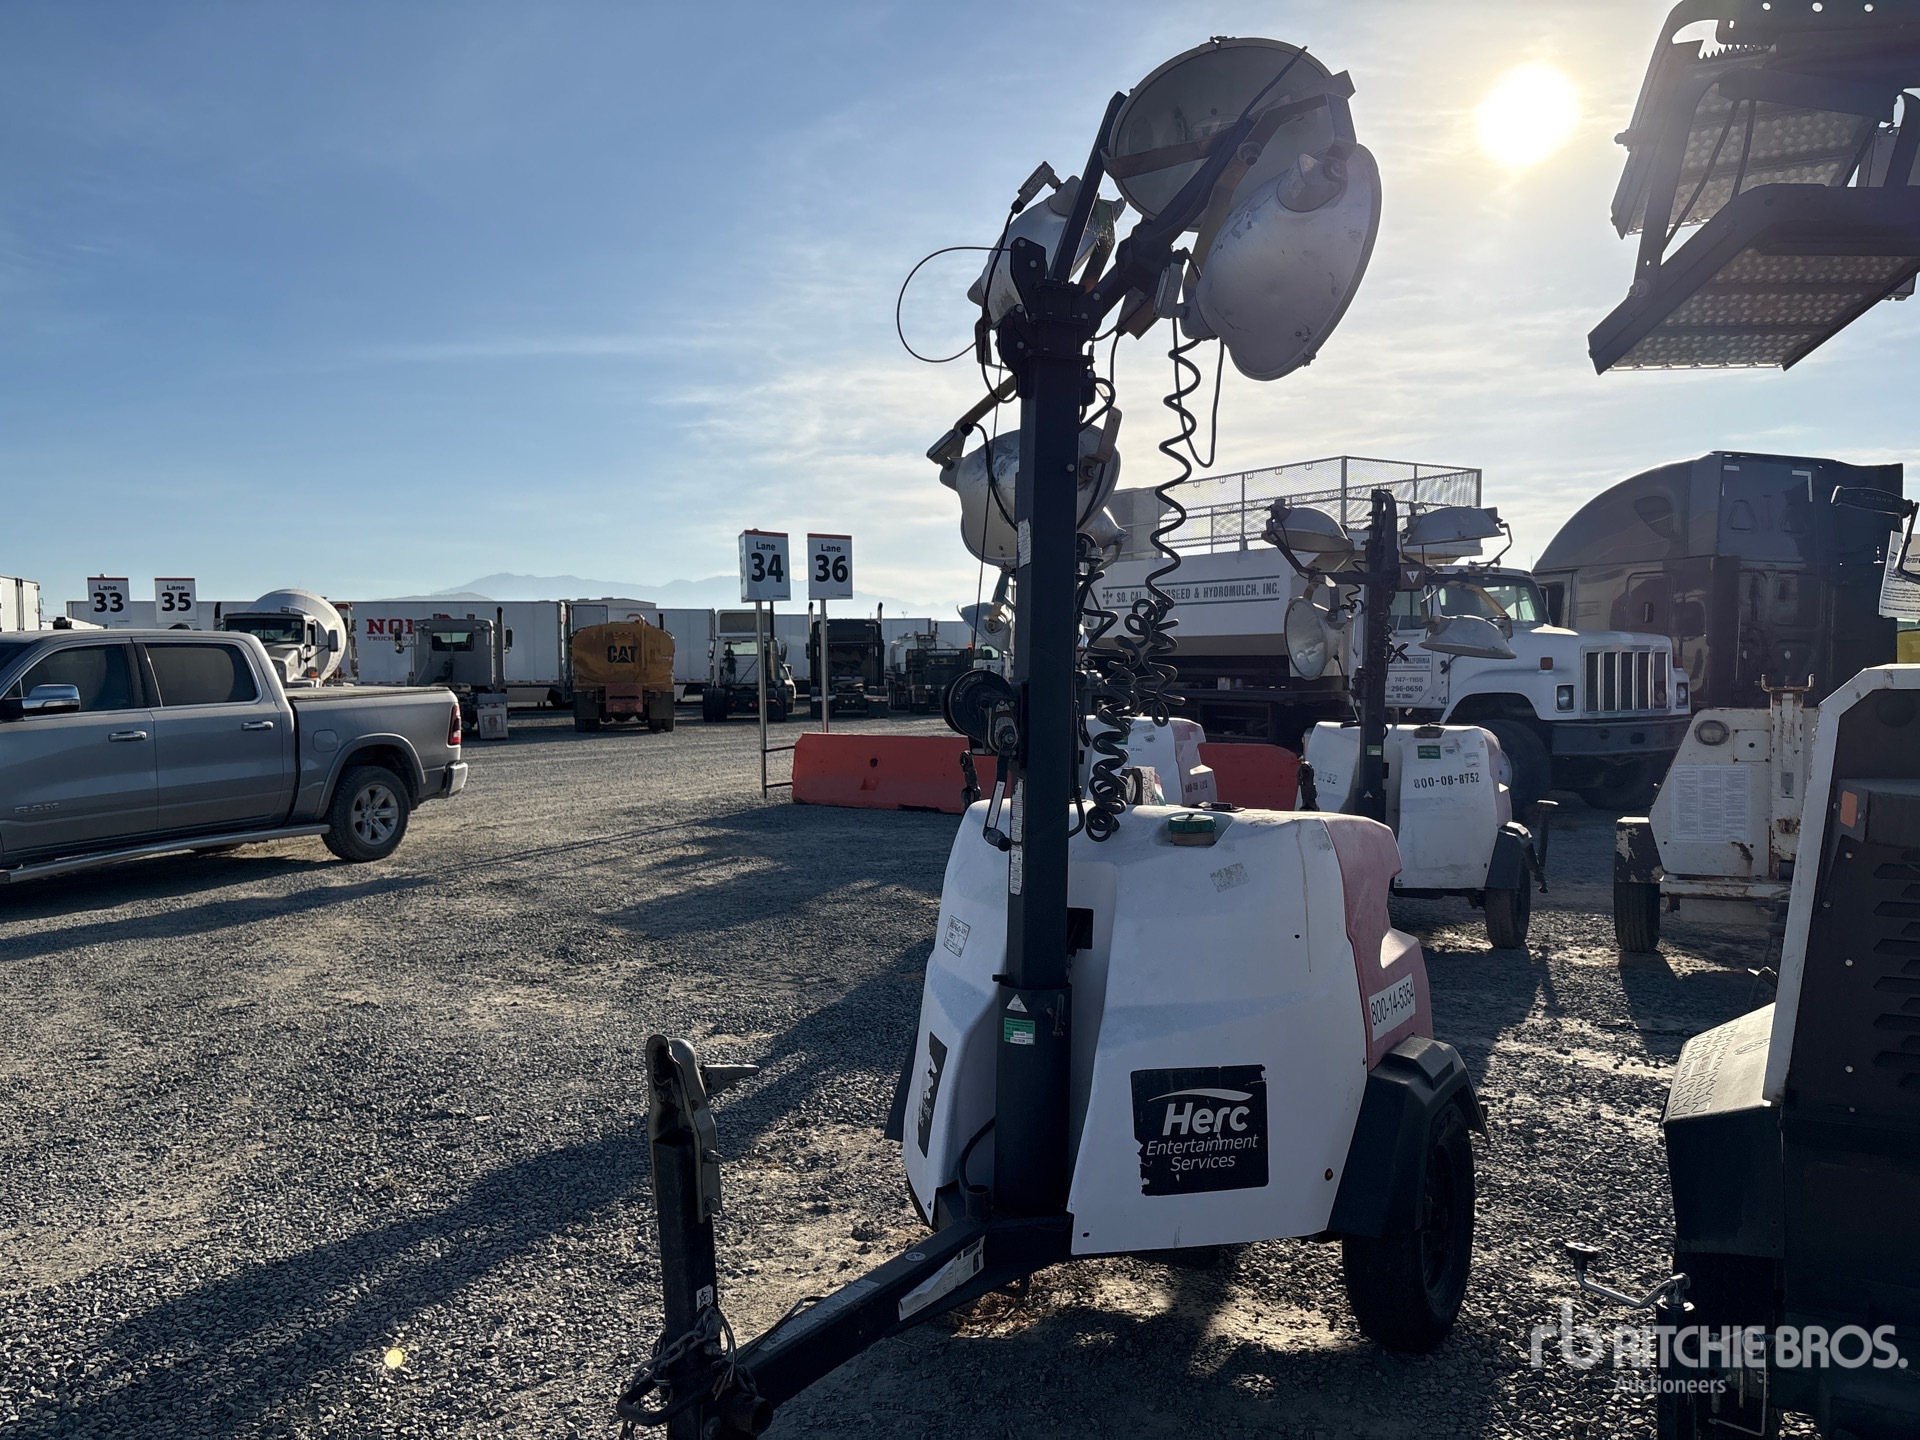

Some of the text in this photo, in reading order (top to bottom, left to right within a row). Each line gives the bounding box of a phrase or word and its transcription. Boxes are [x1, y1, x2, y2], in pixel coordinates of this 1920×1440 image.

[755, 541, 776, 551] Lane
[820, 543, 842, 553] Lane
[750, 552, 784, 583] 34
[815, 554, 848, 583] 36
[93, 592, 124, 612] 33
[161, 592, 191, 611] 35
[1116, 591, 1128, 603] SO.
[1147, 588, 1190, 601] HOSEED
[1194, 587, 1200, 598] &
[1203, 584, 1259, 598] HYDROMULCH,
[1262, 582, 1280, 595] INC.
[607, 645, 637, 663] CAT
[1414, 772, 1480, 789] 800-08-8752
[1162, 1102, 1250, 1136] Herc
[1146, 1134, 1259, 1155] Entertainment
[1170, 1155, 1236, 1171] Services
